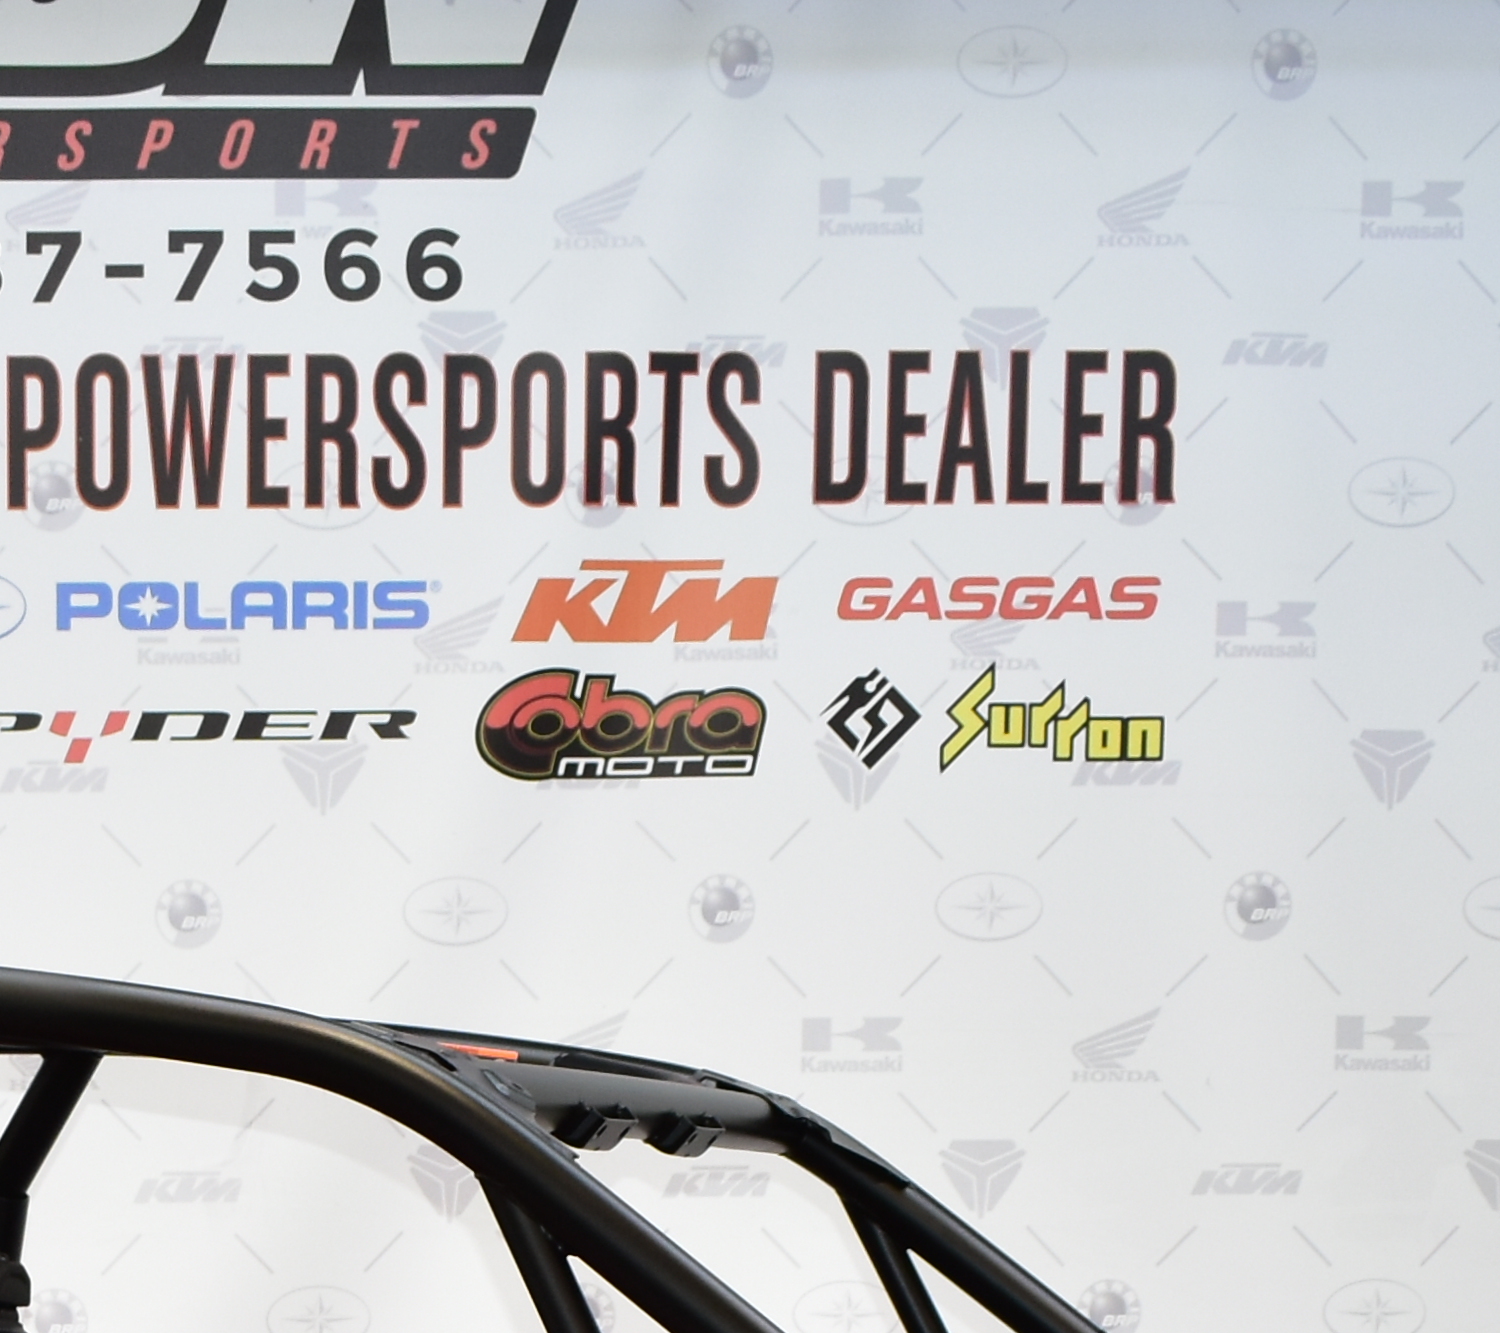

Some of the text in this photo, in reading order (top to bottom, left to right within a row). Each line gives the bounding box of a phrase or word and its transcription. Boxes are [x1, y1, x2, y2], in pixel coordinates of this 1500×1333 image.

[818, 218, 924, 237] Kawasaki
[1359, 221, 1464, 240] Kawasaki
[553, 235, 646, 250] HONDA
[1098, 234, 1190, 248] HONDA
[1222, 331, 1328, 367] KTM
[5, 349, 762, 512] POWERSPORTS
[811, 347, 1178, 506] DEALER
[55, 579, 429, 631] POLARIS
[510, 558, 780, 642] KTM
[836, 575, 1162, 621] GASGAS
[136, 647, 241, 666] Kawasaki
[673, 643, 778, 662] Kawasaki
[1214, 640, 1317, 658] Kawasaki
[414, 660, 505, 675] HONDA
[950, 657, 1041, 671] HONDA
[558, 755, 754, 777] MOTO
[0, 760, 109, 793] KTM
[801, 1055, 904, 1073] Kawasaki
[1334, 1053, 1432, 1071] Kawasaki
[1071, 1069, 1162, 1083] HONDA
[134, 1170, 243, 1204] KTM
[662, 1165, 772, 1199] KTM
[1191, 1163, 1302, 1196] KTM
